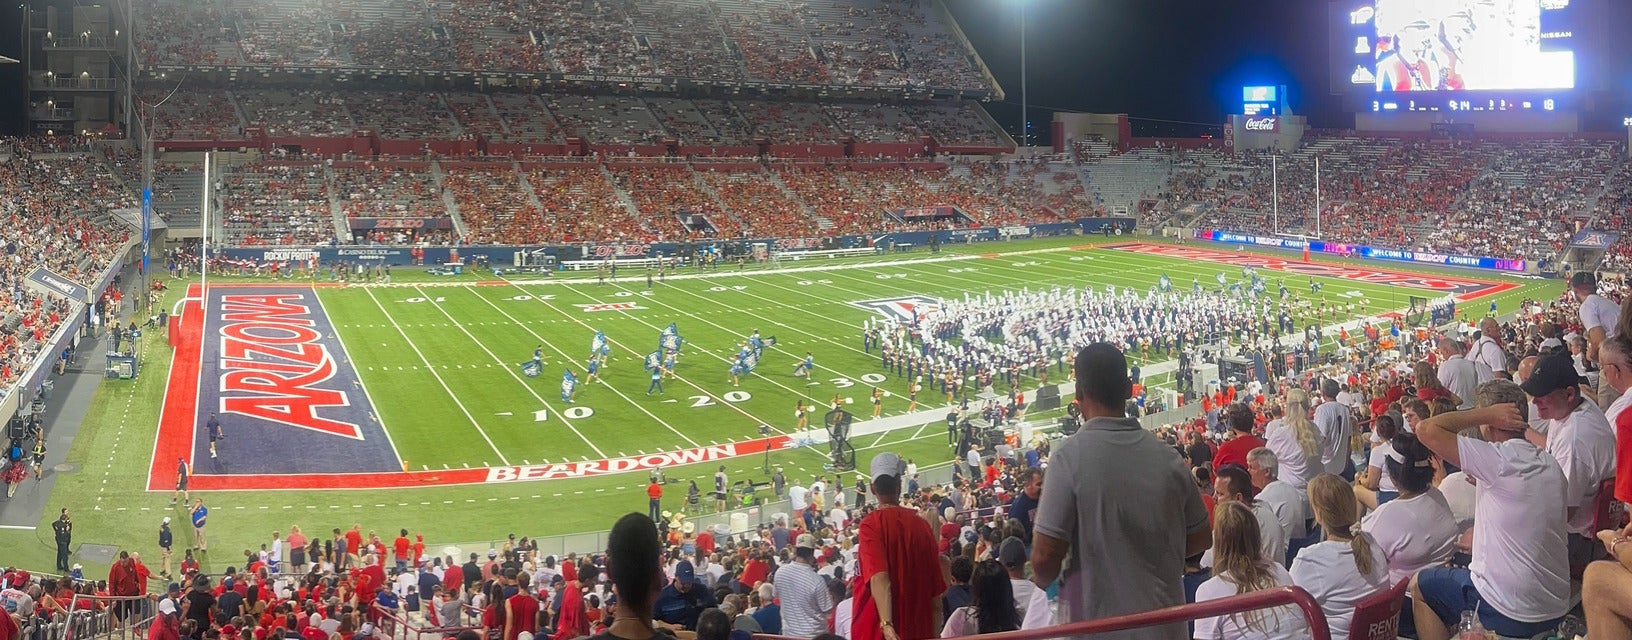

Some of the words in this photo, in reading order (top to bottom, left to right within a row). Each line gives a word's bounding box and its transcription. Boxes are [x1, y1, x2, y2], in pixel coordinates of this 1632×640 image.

[1540, 31, 1572, 39] NISSAN
[1449, 100, 1470, 111] 9:14
[1543, 98, 1554, 111] 18
[1222, 233, 1247, 243] WELCOME
[1372, 248, 1402, 258] WELCOME
[1403, 251, 1412, 259] TO
[1449, 255, 1480, 266] COUNTRY
[219, 294, 365, 440] ARIZONA
[828, 373, 887, 388] 30
[687, 390, 752, 408] 20
[530, 406, 594, 422] 10
